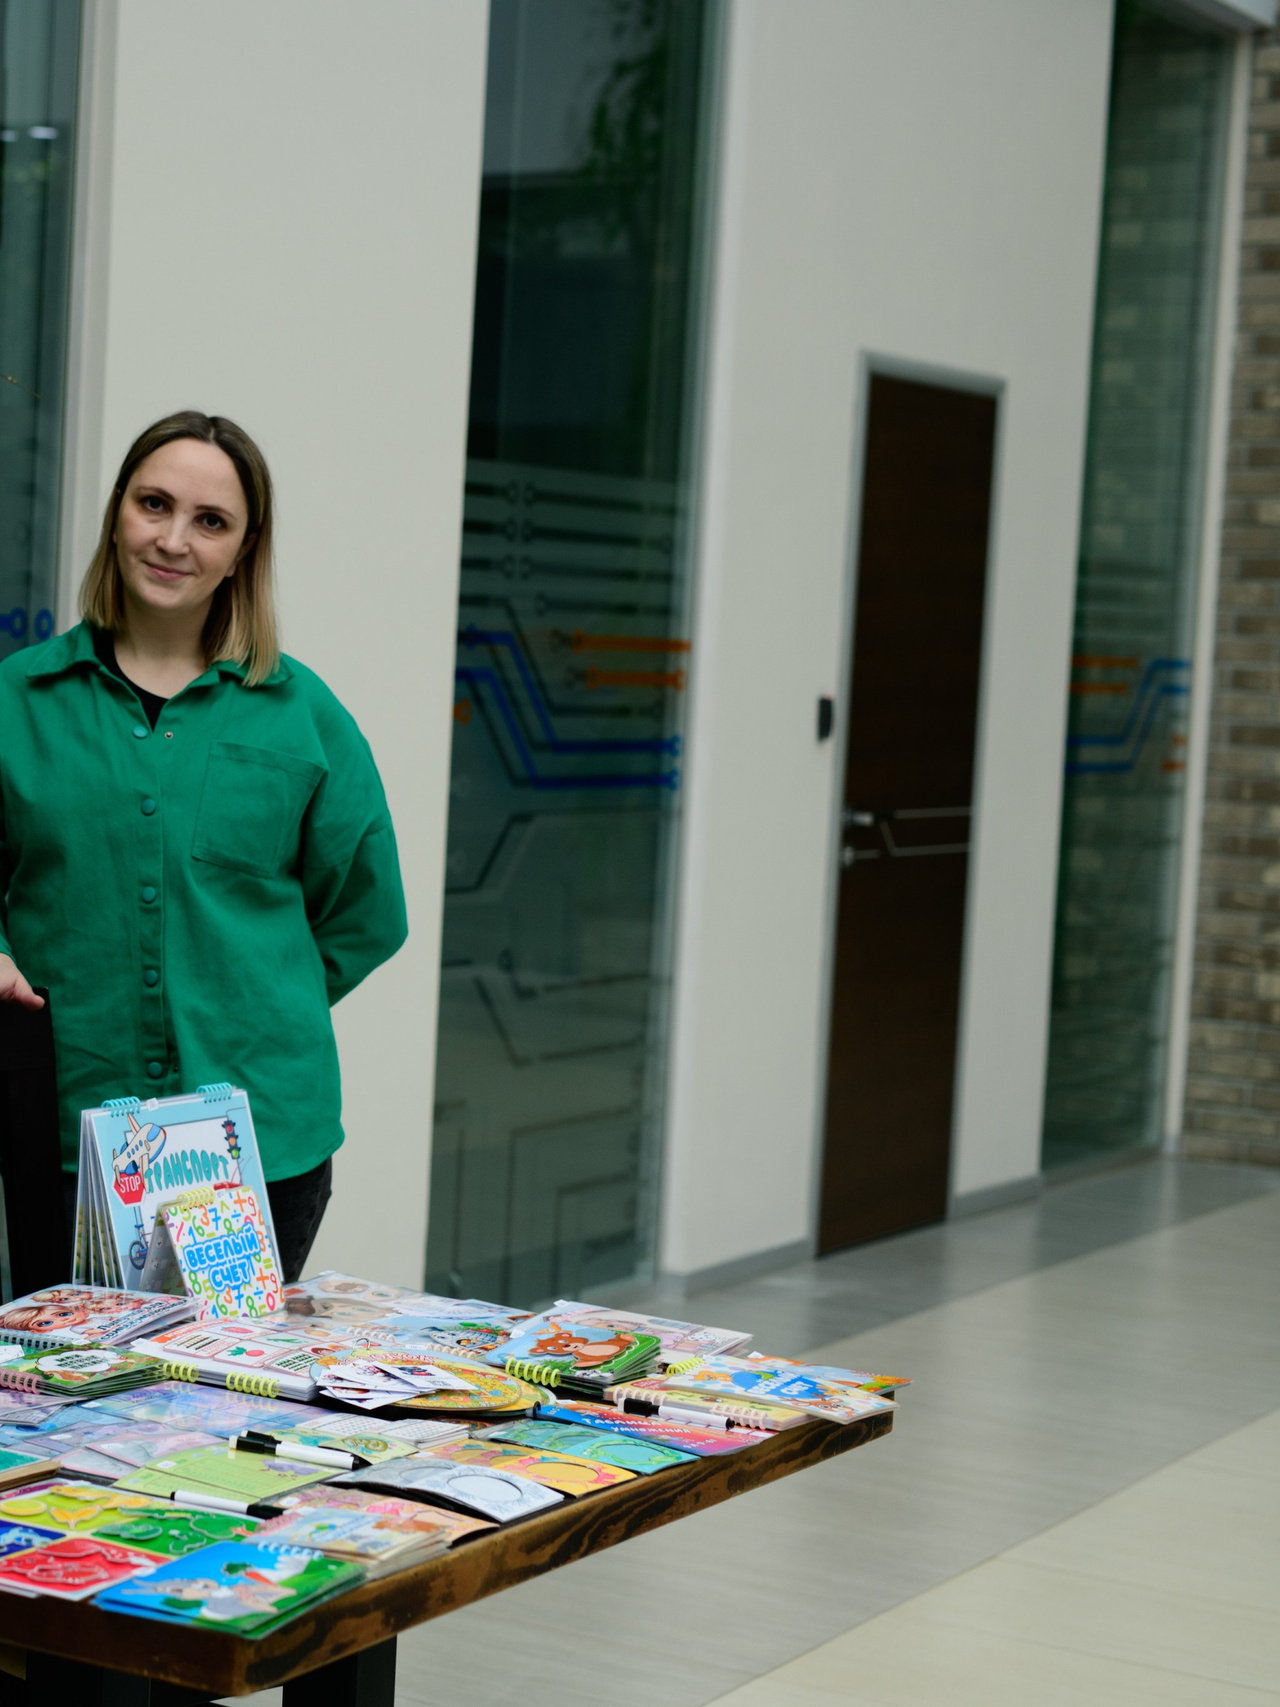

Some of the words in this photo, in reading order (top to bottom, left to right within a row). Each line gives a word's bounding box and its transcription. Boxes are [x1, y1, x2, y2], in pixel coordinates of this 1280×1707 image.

[120, 1174, 141, 1194] STOP
[144, 1150, 230, 1194] ТРАНСПОРТ
[185, 1224, 261, 1269] ВЕСЕЛЫЙ
[210, 1257, 250, 1290] СЧЁТ
[582, 1418, 662, 1427] ТАБЛИЦА
[611, 1426, 691, 1434] УМНОЖЕНИЯ
